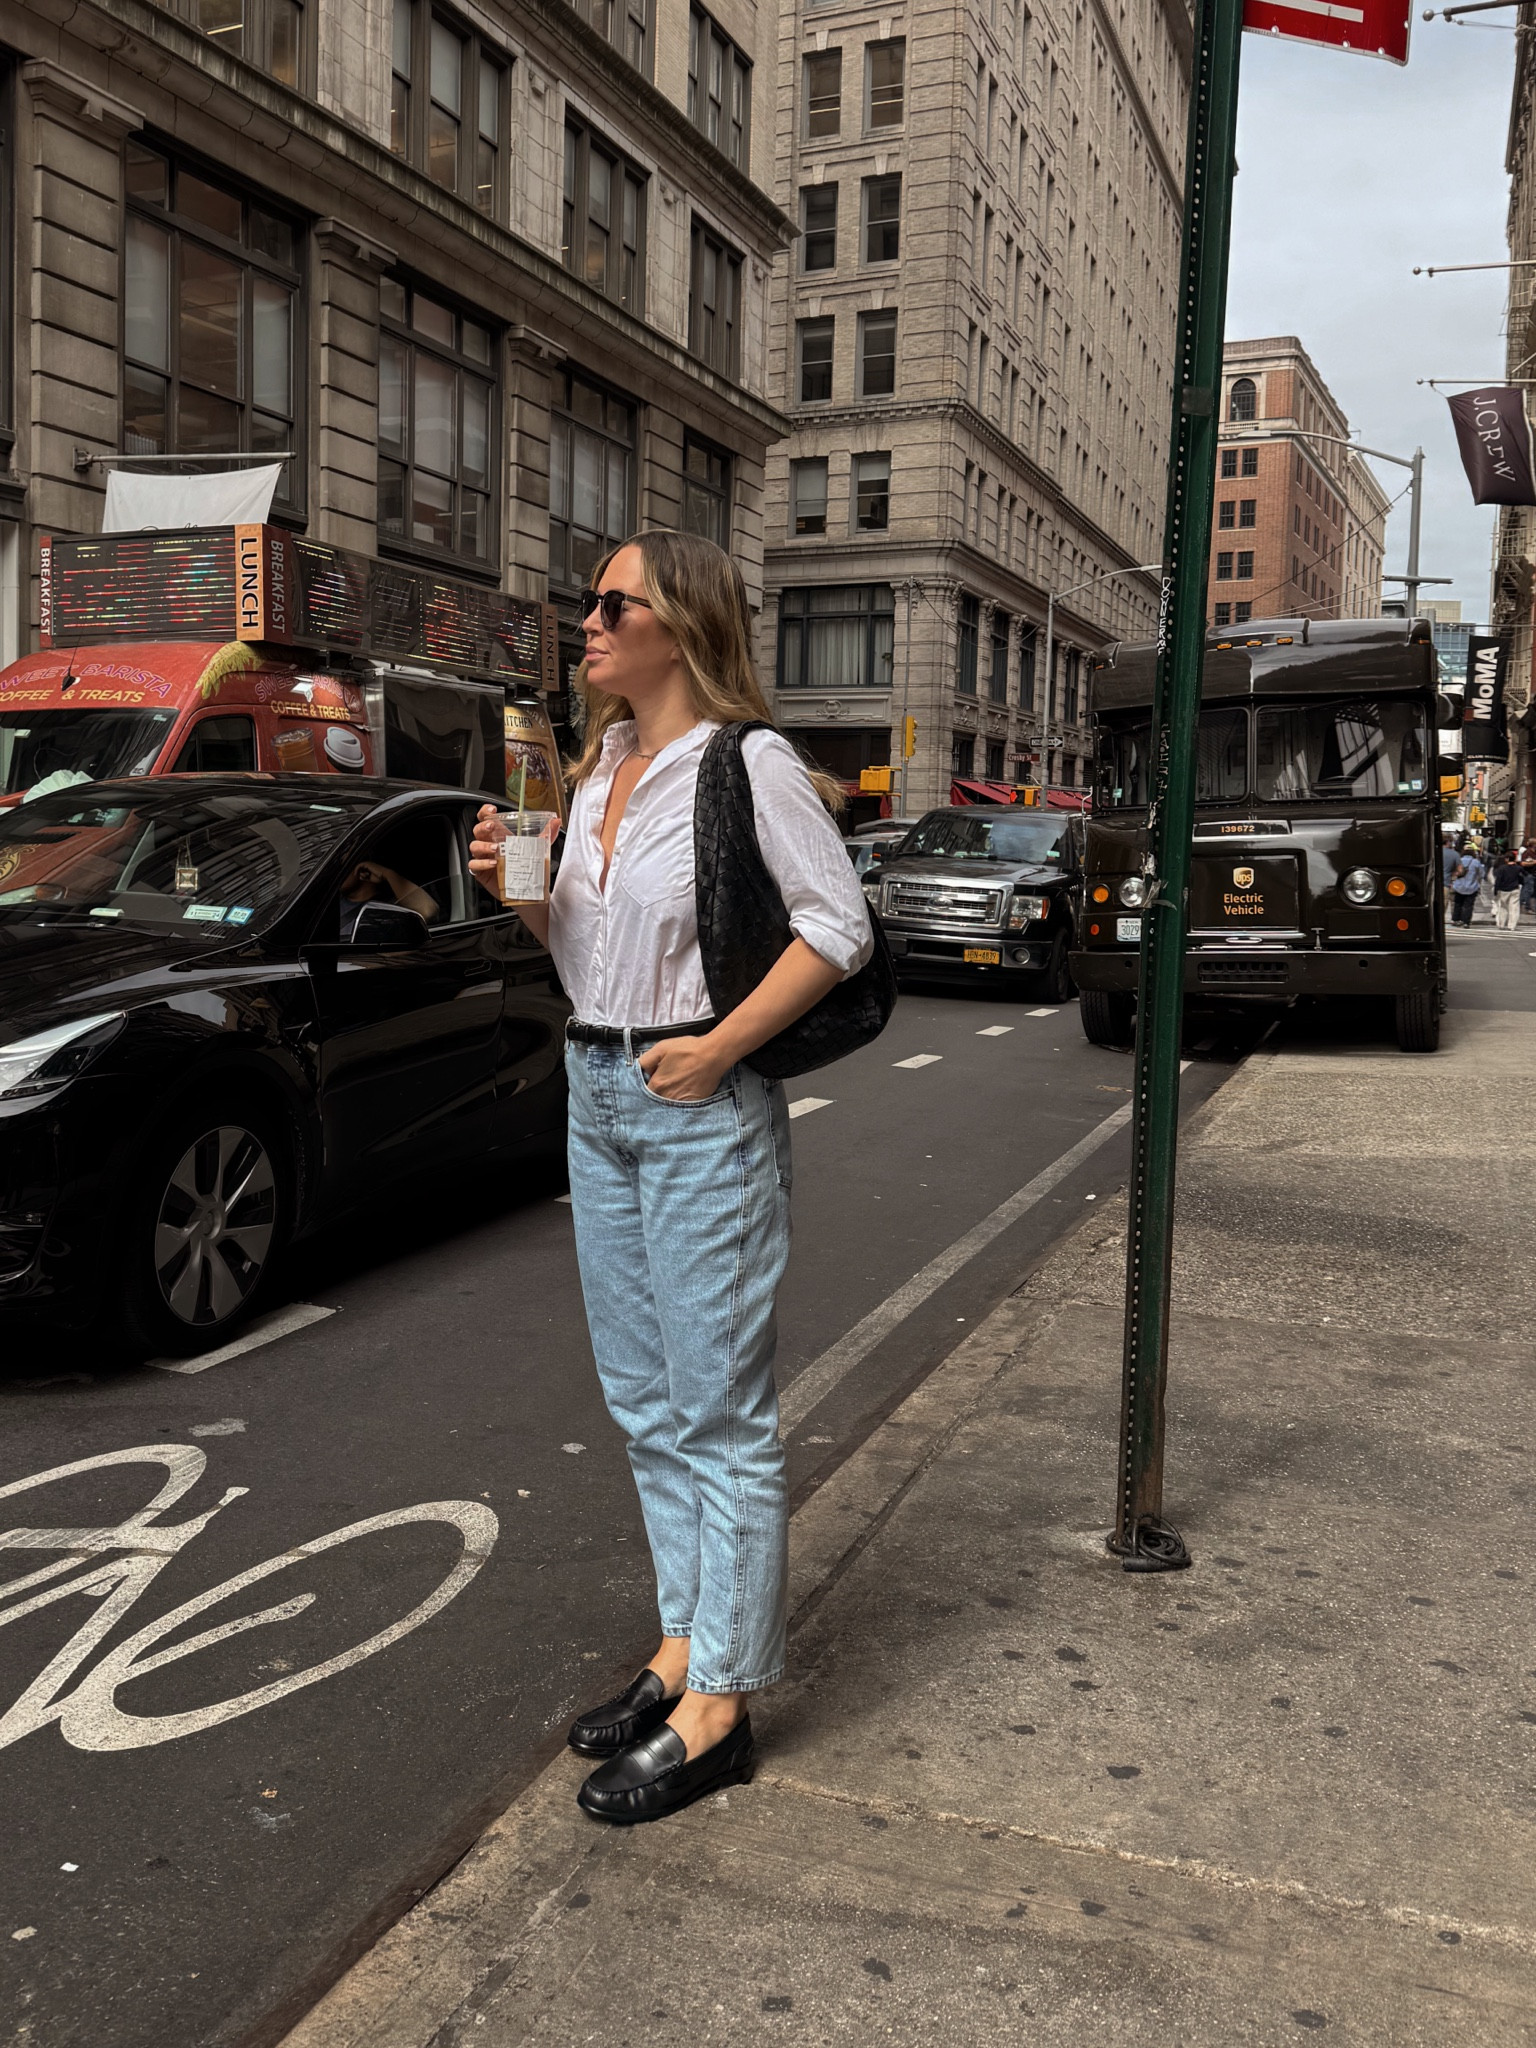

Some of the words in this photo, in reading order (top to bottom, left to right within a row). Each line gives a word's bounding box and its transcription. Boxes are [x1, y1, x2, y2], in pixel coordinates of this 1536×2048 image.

[1473, 397, 1516, 481] J.CREW
[40, 547, 51, 635] BREAKFAST
[239, 537, 259, 628] LUNCH
[270, 539, 285, 634] BREAKFAST
[545, 614, 555, 682] LUNCH
[80, 663, 172, 699] BARISTA
[1471, 646, 1500, 720] MoMA
[0, 689, 54, 702] OFFEE
[61, 689, 75, 701] &
[78, 689, 146, 703] TREATS
[270, 700, 309, 717] COFFEE
[309, 704, 317, 717] &
[317, 704, 351, 720] TREATS
[504, 715, 533, 729] ITCHEN
[1008, 754, 1026, 762] Crosby
[1221, 825, 1256, 833] 139672
[1223, 893, 1264, 903] Electric
[1223, 905, 1264, 915] Vehicle
